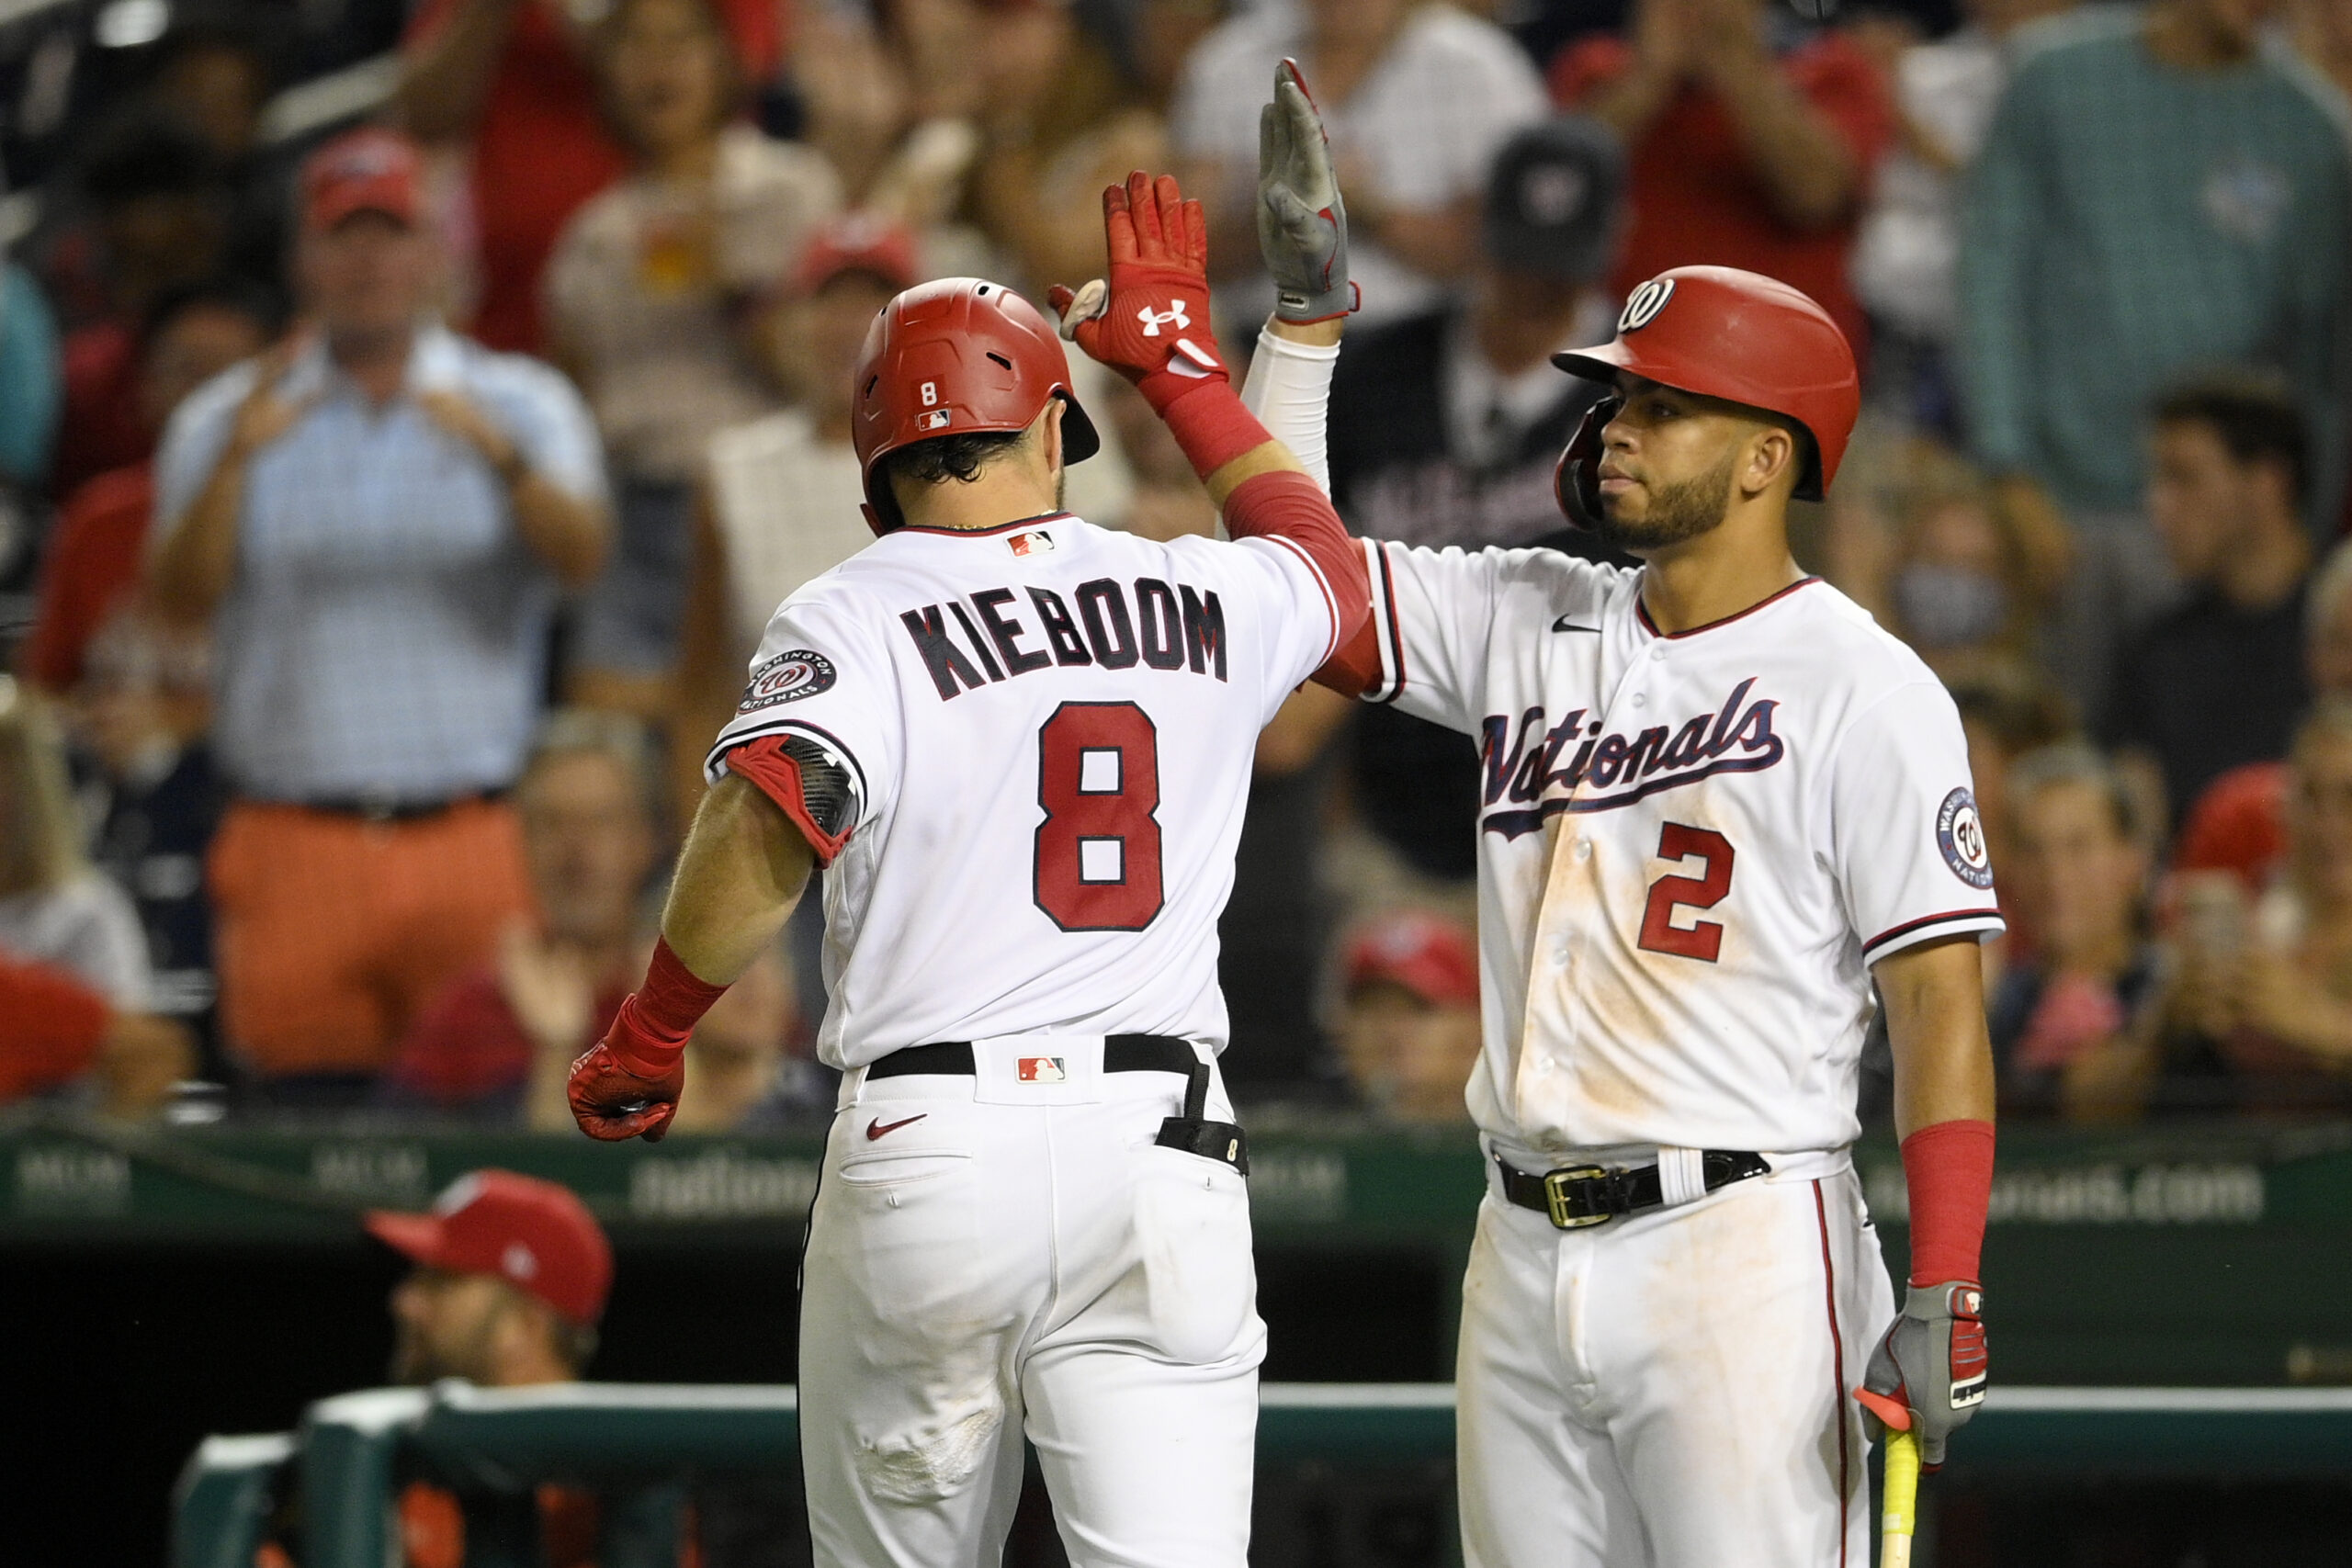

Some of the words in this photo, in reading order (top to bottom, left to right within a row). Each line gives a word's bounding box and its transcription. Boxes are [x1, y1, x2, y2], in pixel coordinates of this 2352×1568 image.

[921, 381, 937, 407] 8
[900, 577, 1228, 702] KIEBOOM
[1481, 676, 1784, 807] Nationals
[1033, 700, 1166, 933] 8
[1637, 821, 1736, 963] 2
[1227, 1138, 1238, 1162] 8
